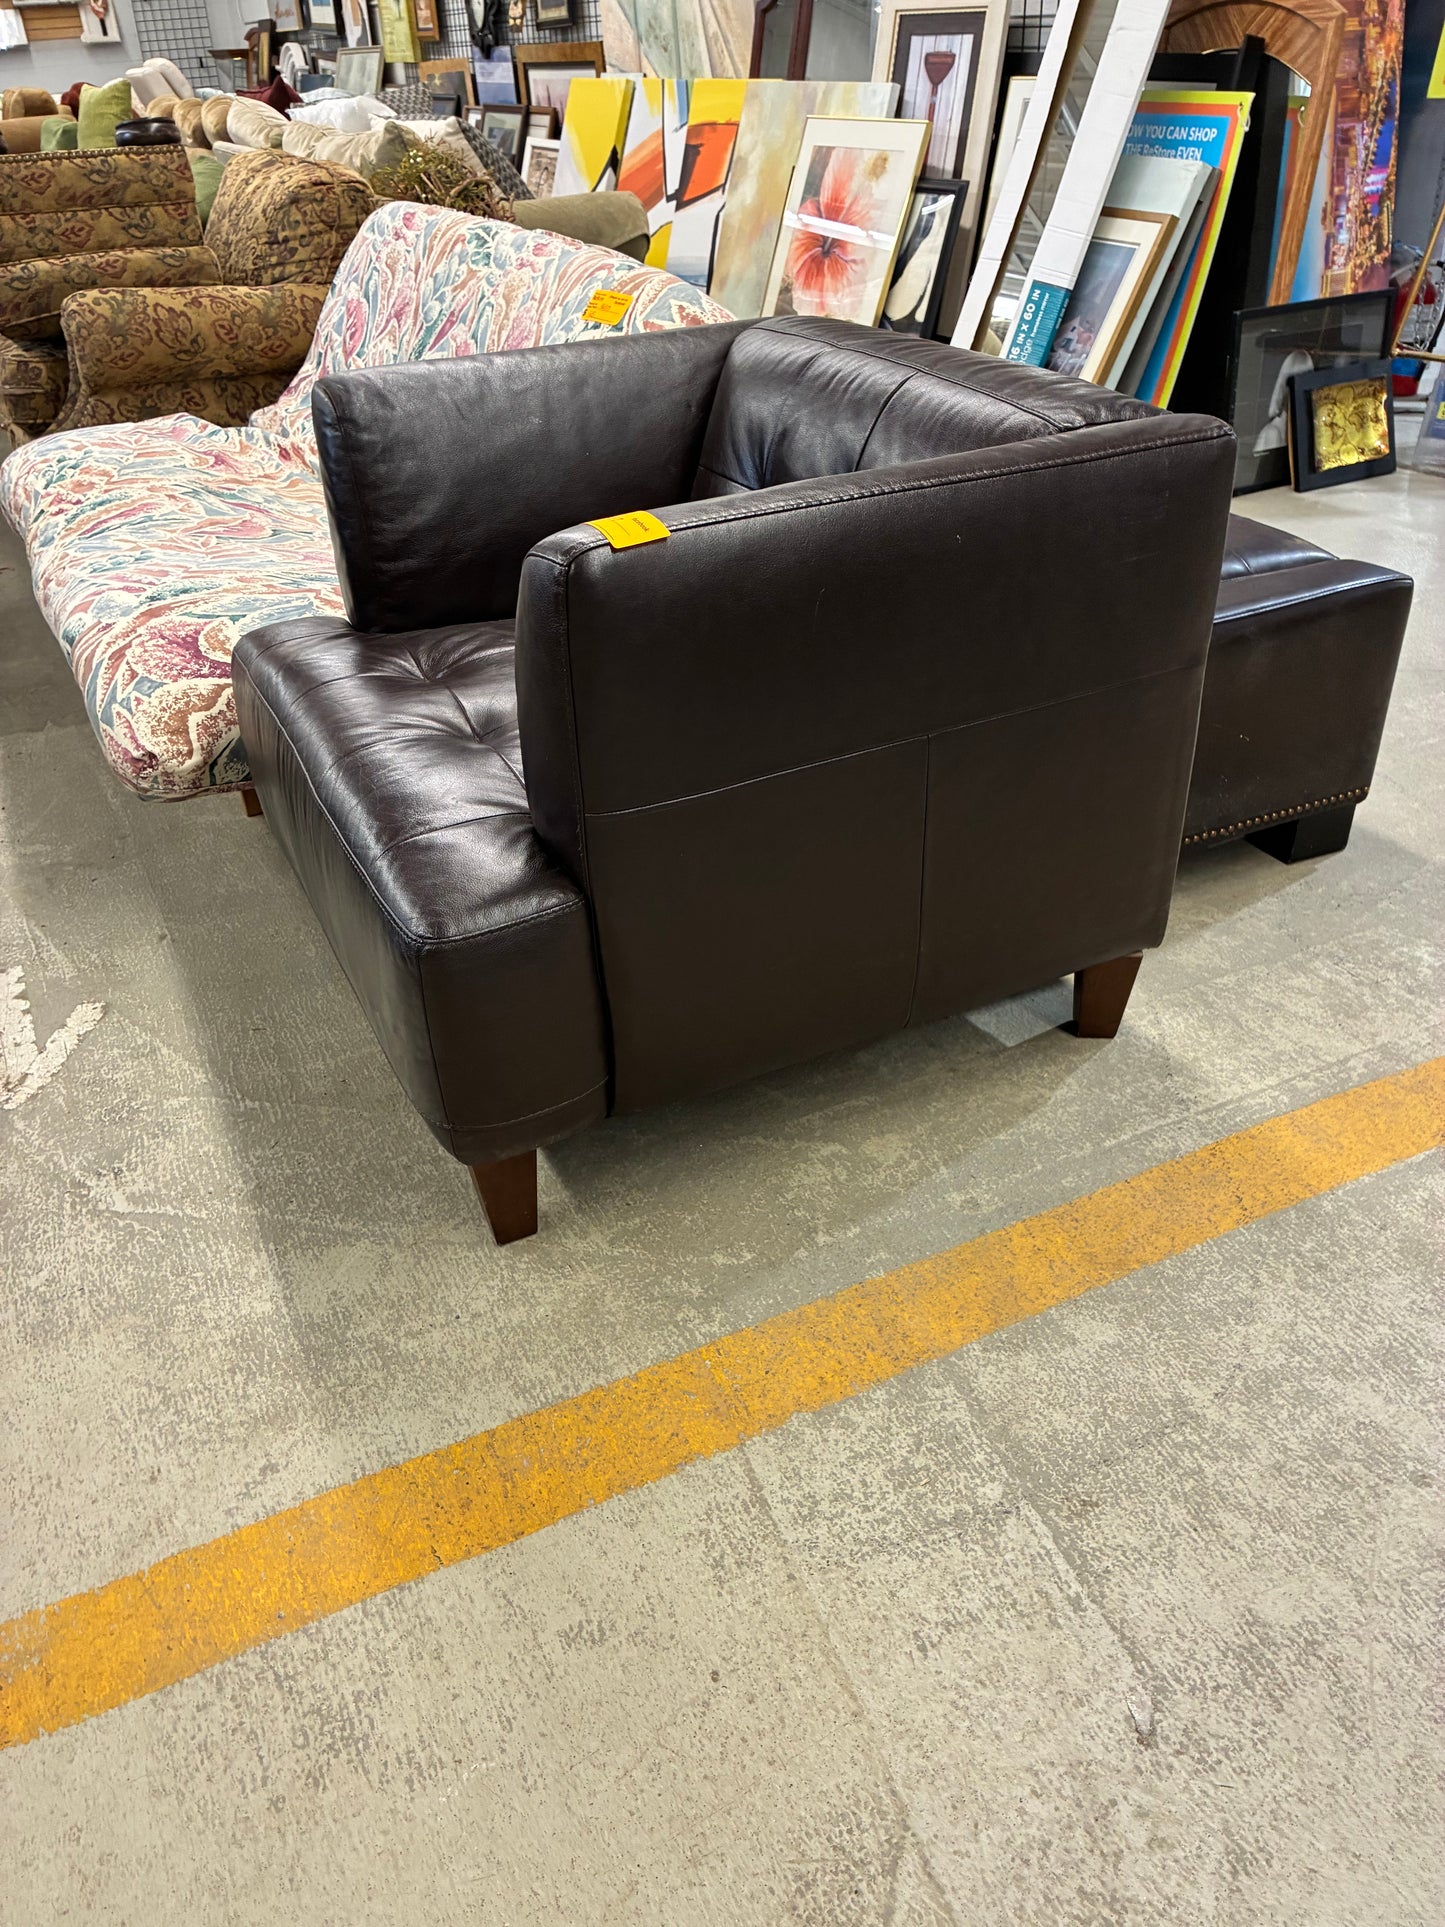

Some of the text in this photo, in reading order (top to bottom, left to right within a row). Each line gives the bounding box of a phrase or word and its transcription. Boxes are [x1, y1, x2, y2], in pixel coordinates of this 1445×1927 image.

[1128, 124, 1217, 142] OW YOU CAN SHOP
[1126, 143, 1203, 162] THE ReStore EVEN
[1009, 346, 1021, 360] 16
[1016, 333, 1026, 344] IN
[1023, 303, 1036, 320] 60
[1031, 289, 1041, 301] IN
